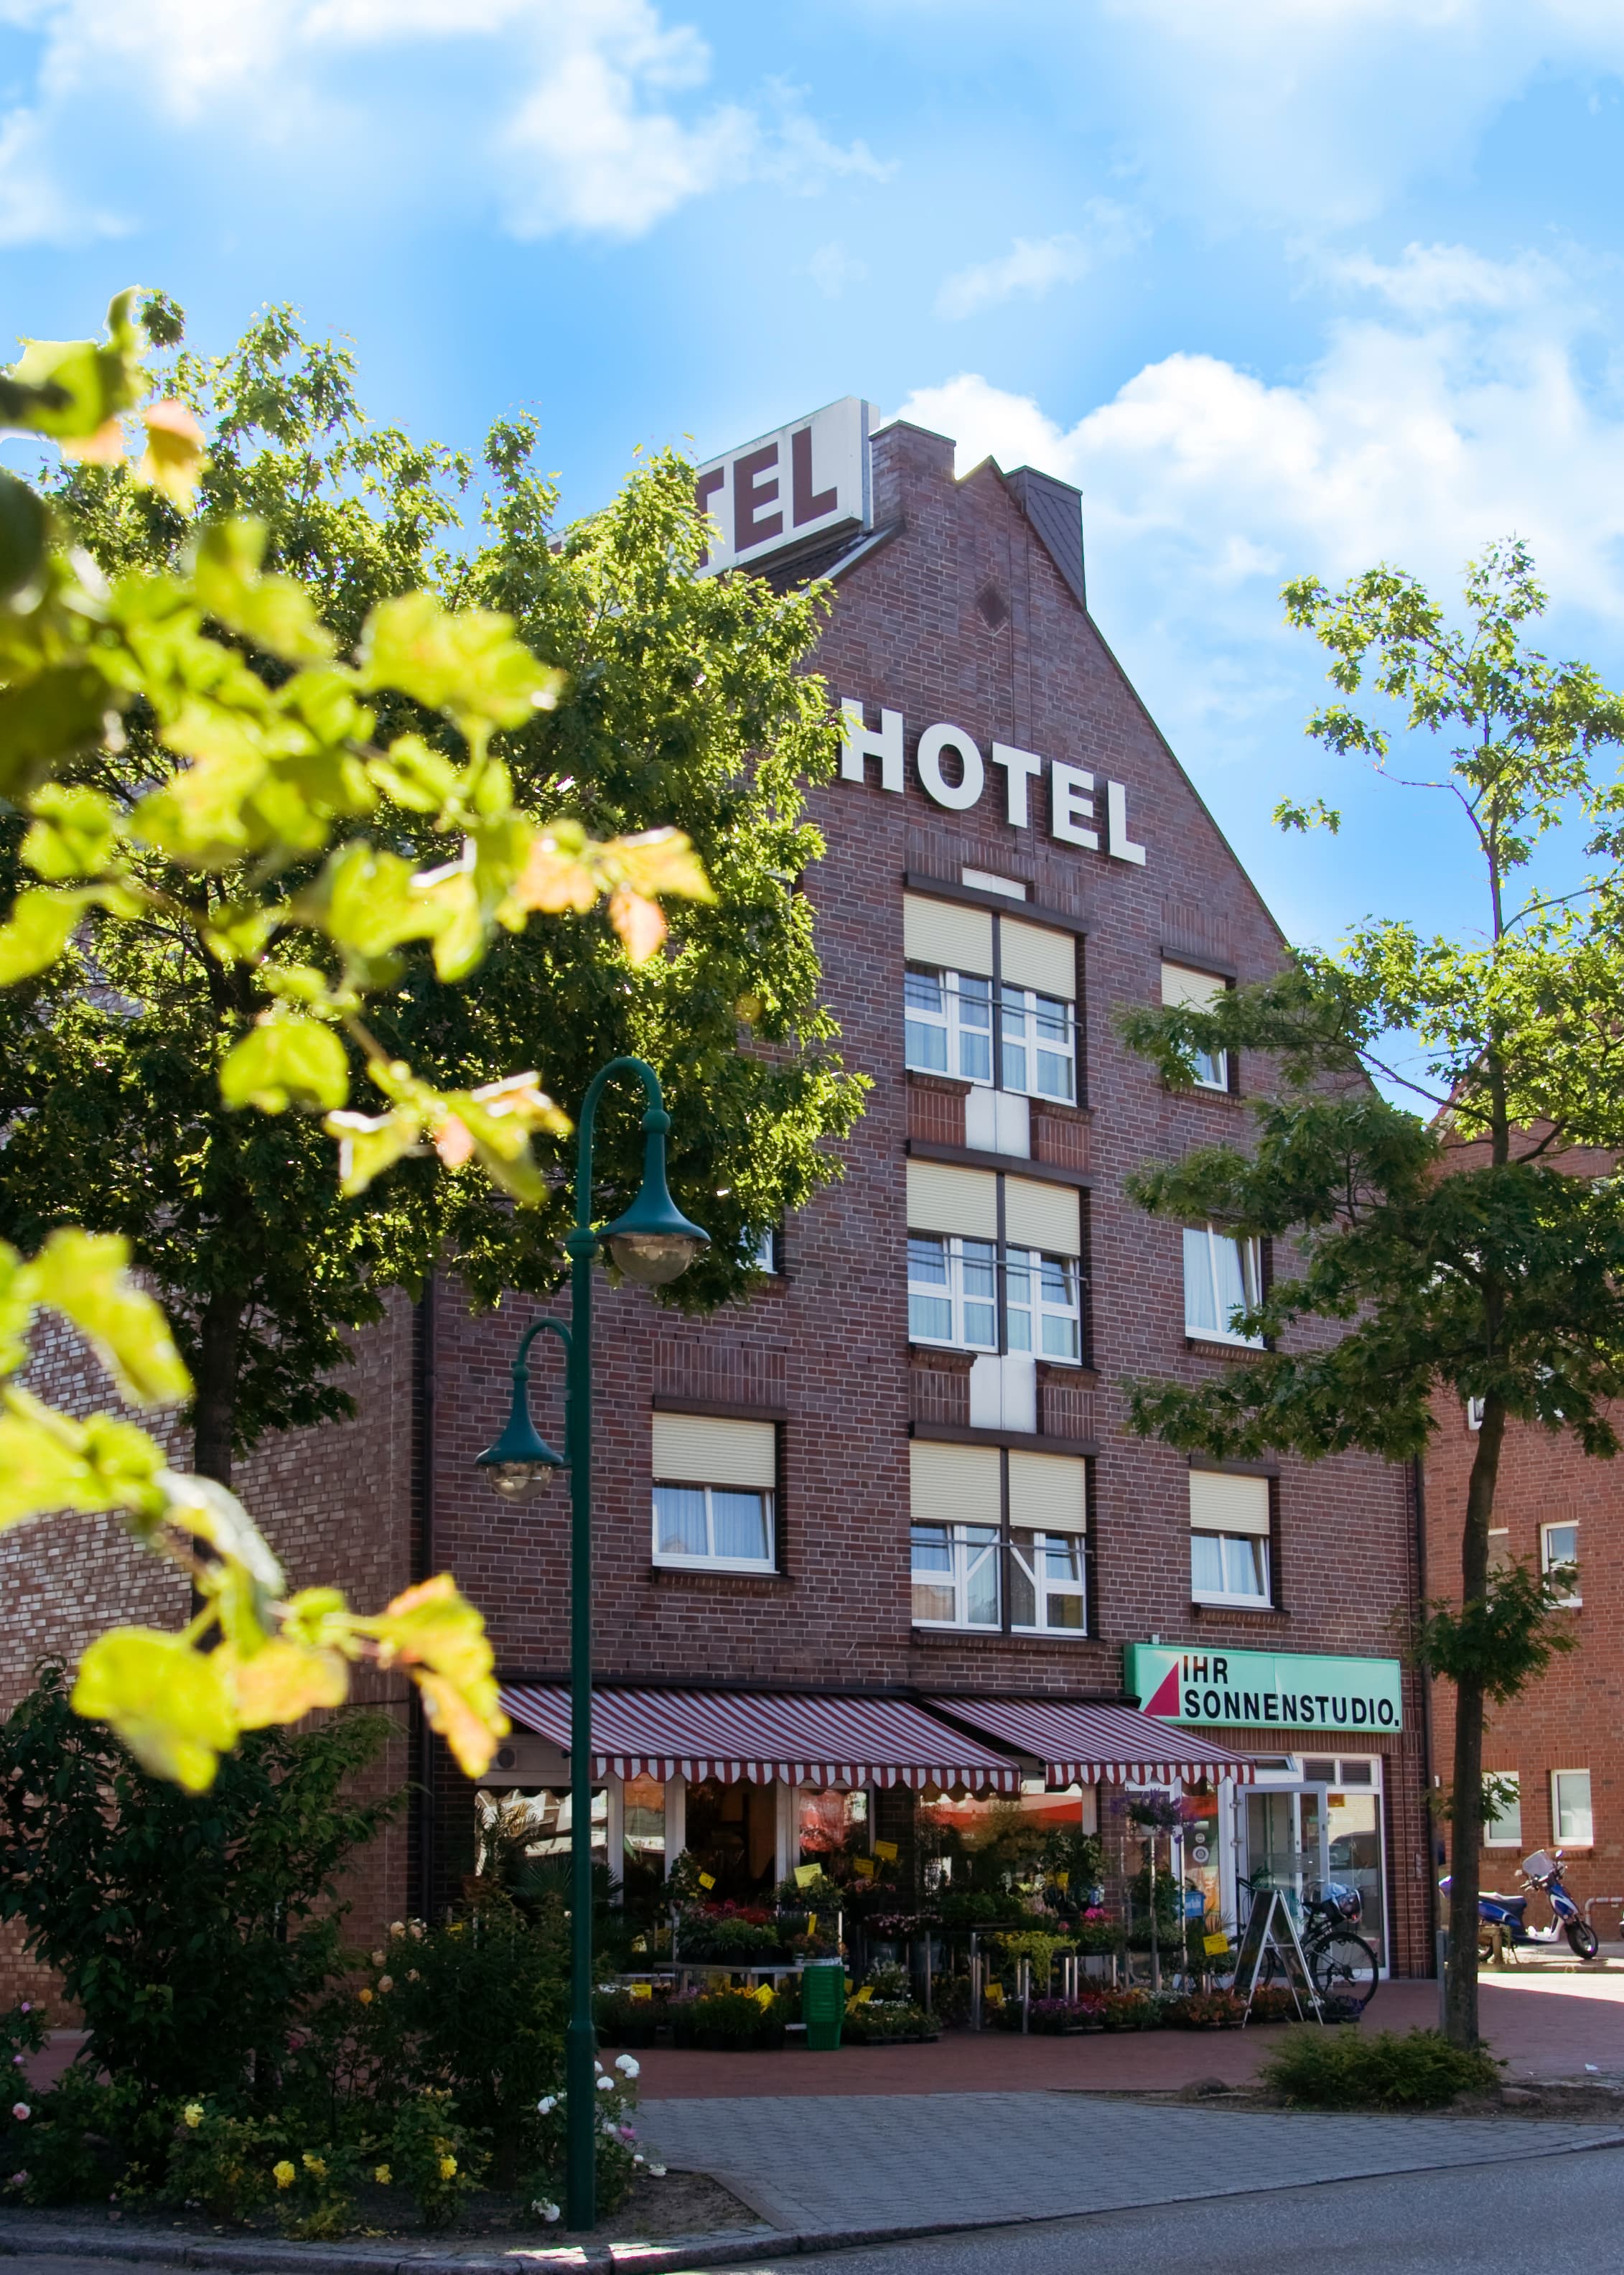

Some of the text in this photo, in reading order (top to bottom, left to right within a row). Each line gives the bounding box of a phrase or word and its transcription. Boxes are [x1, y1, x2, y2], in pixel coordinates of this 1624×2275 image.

[841, 697, 1146, 866] HOTEL
[1183, 1655, 1228, 1684] IHR
[1184, 1689, 1400, 1727] SONNENSTUDIO.
